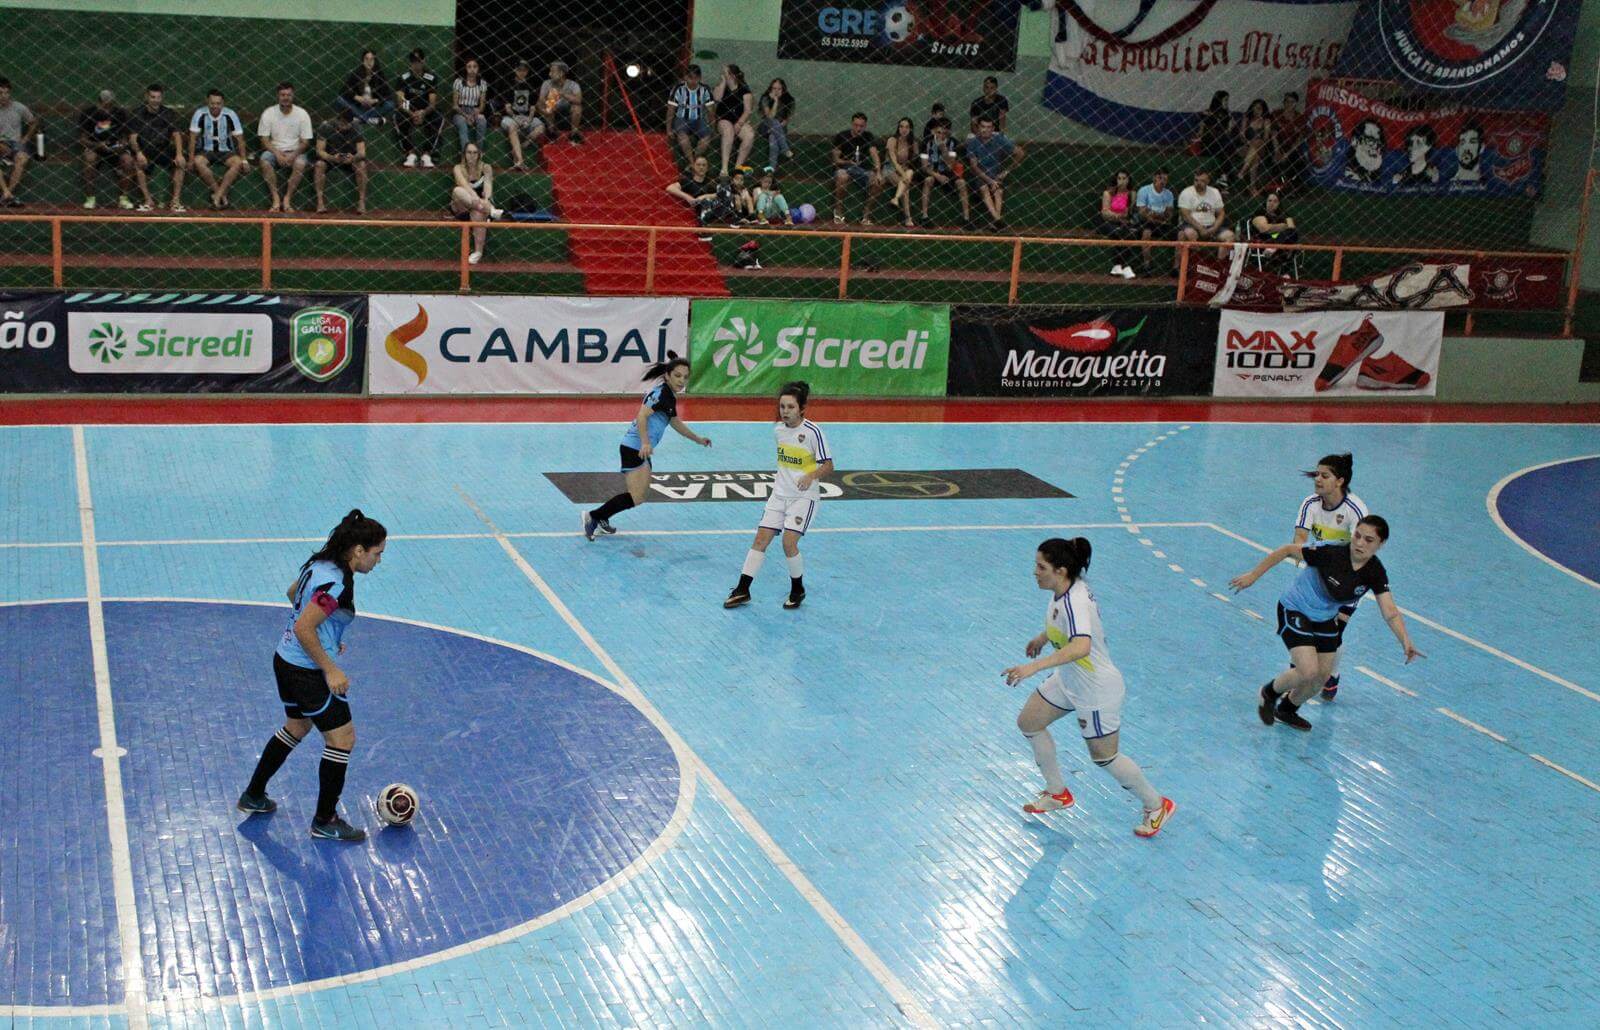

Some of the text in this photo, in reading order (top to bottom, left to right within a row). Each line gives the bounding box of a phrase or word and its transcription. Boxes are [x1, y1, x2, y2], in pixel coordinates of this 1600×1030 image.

[931, 41, 980, 55] SPORTS
[1393, 29, 1525, 78] NUNCA TE ABANDONAMOS
[311, 316, 332, 325] LIGA
[135, 327, 253, 358] Sicredi
[439, 318, 672, 363] CAMBAÍ
[772, 326, 929, 370] Sicredi
[1226, 329, 1317, 359] MAX
[1002, 349, 1167, 387] Malaguetta
[1226, 351, 1316, 369] 1000
[1001, 378, 1072, 387] Restaurante
[1253, 374, 1303, 382] PENALTY
[651, 473, 778, 482] NERGIA
